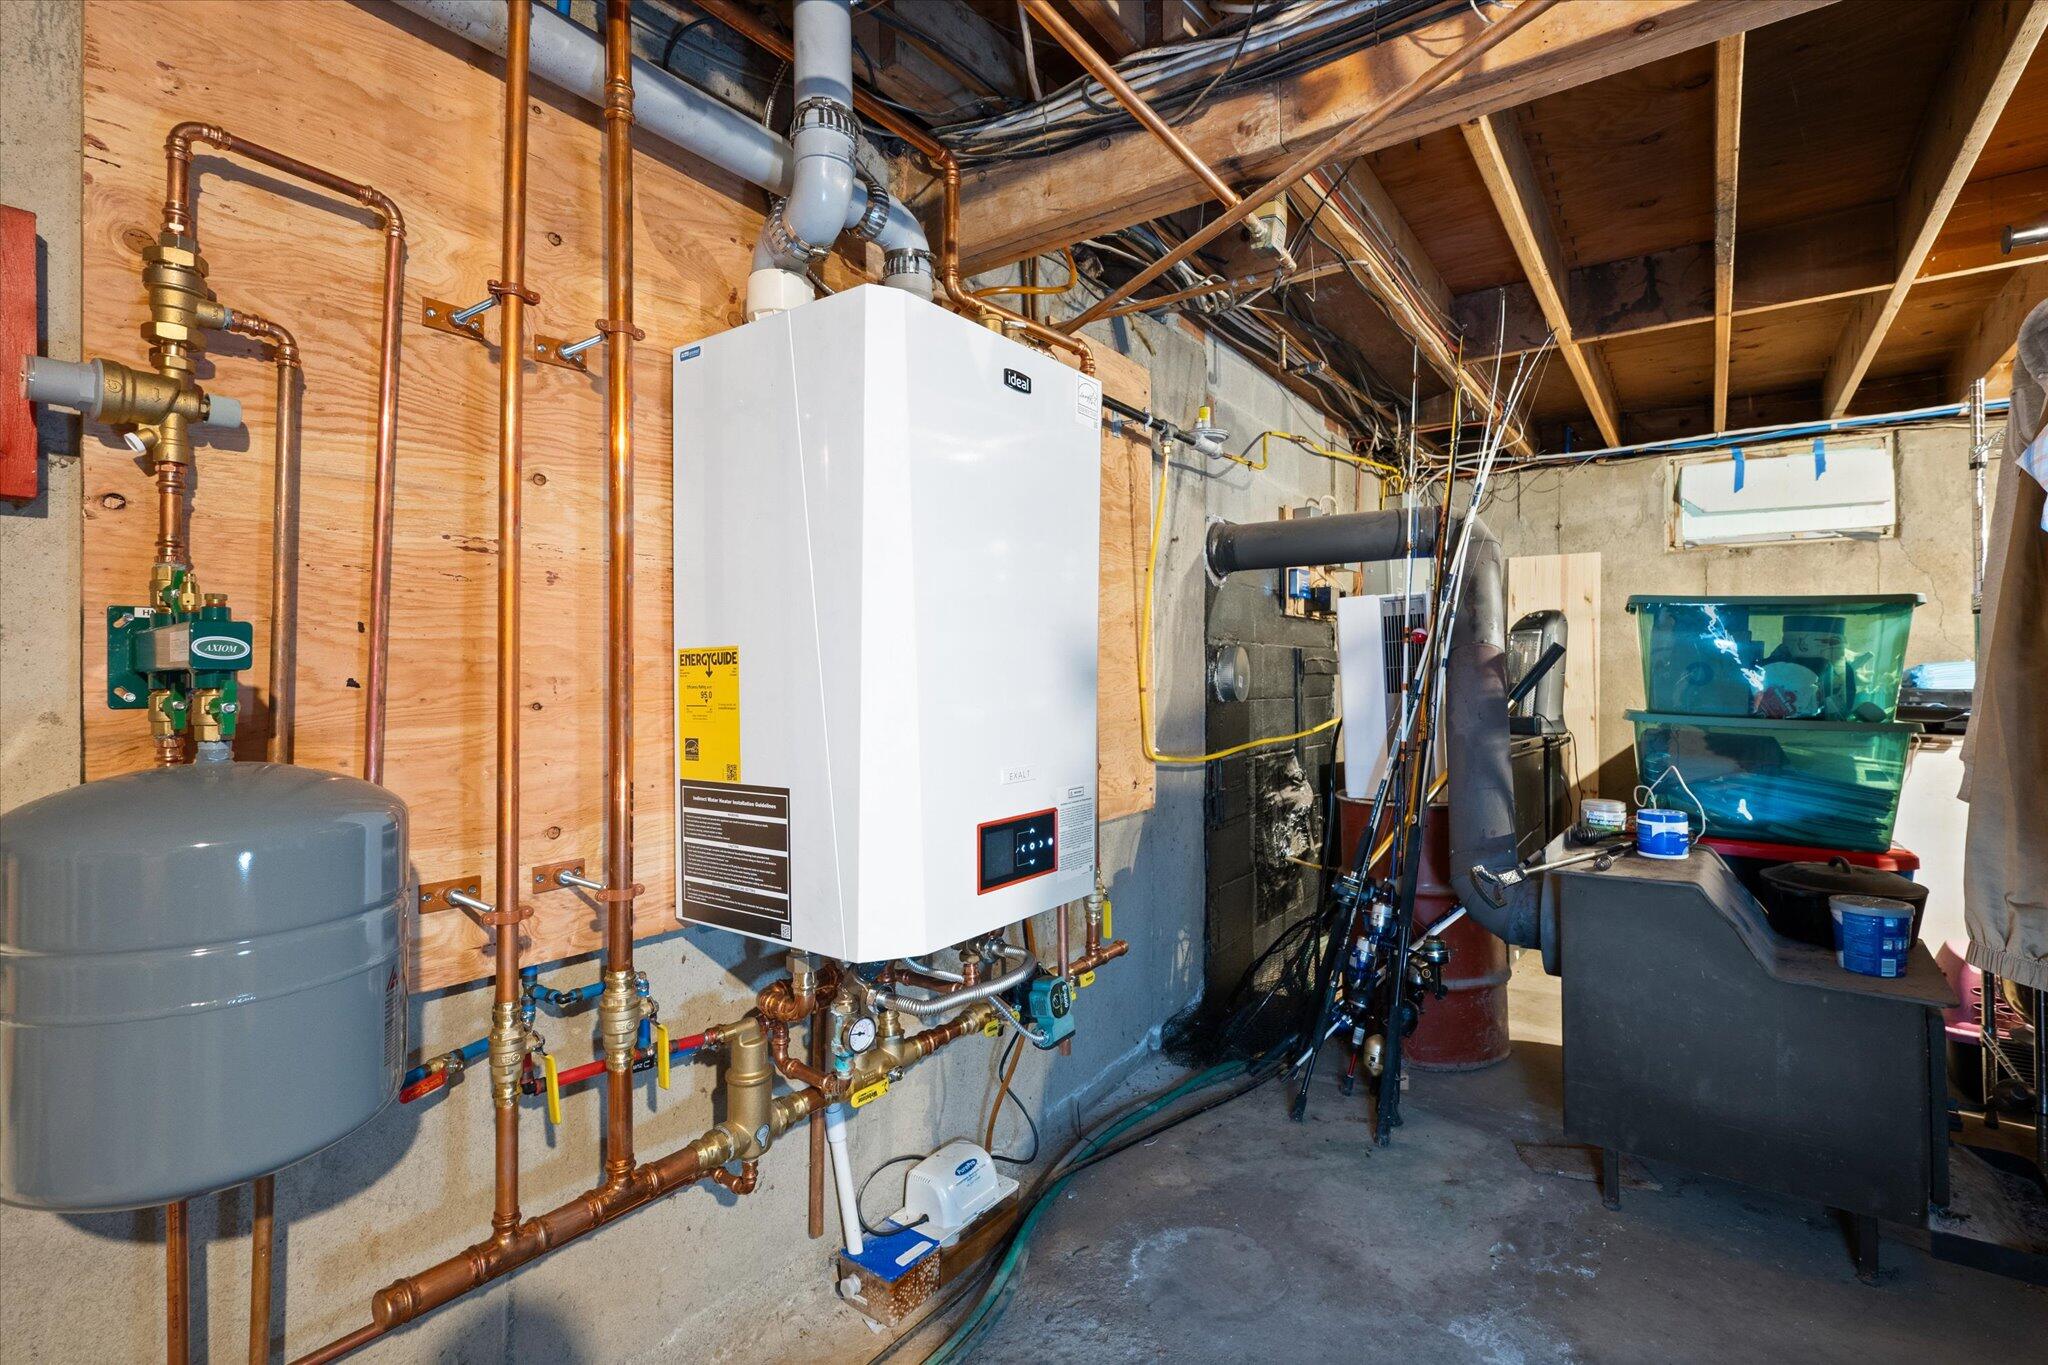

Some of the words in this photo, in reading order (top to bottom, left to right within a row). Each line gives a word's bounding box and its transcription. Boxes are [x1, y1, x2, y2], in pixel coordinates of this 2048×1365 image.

[1008, 371, 1029, 391] ideal
[205, 644, 238, 653] AXIOM
[680, 651, 737, 666] ENERGYGUIDE
[1009, 769, 1030, 780] EXALT
